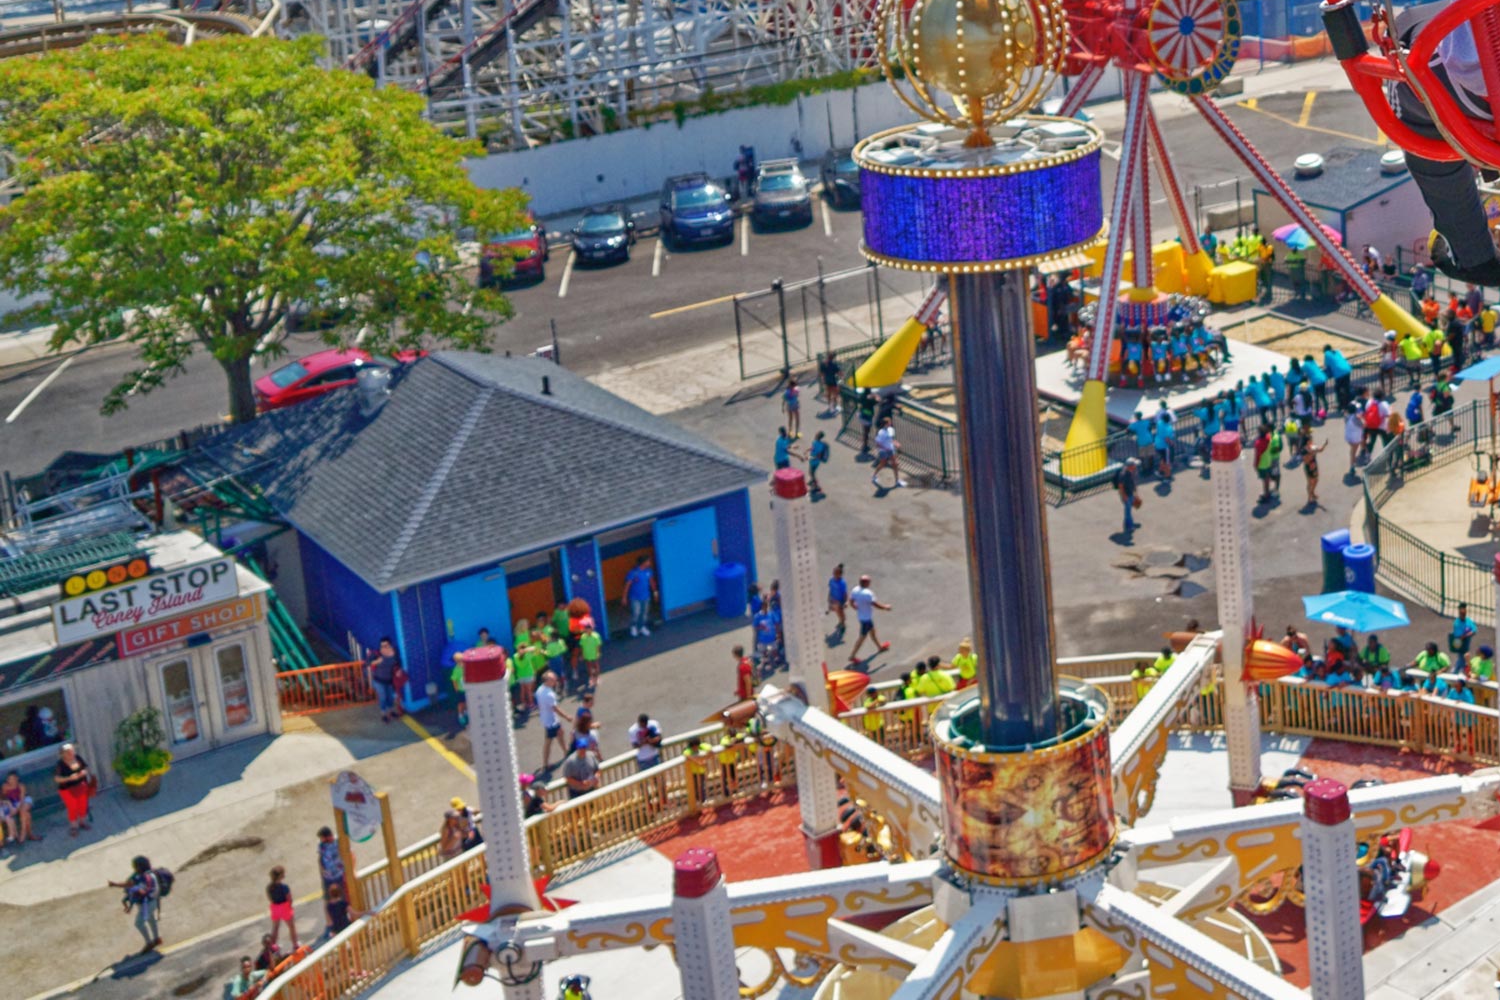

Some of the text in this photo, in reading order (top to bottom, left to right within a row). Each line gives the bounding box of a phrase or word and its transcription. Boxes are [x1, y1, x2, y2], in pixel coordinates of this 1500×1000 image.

[60, 561, 229, 625] LAST STOP
[68, 560, 145, 593] LUNA
[92, 587, 203, 629] Coney Island
[132, 605, 246, 647] GIFT SHOP
